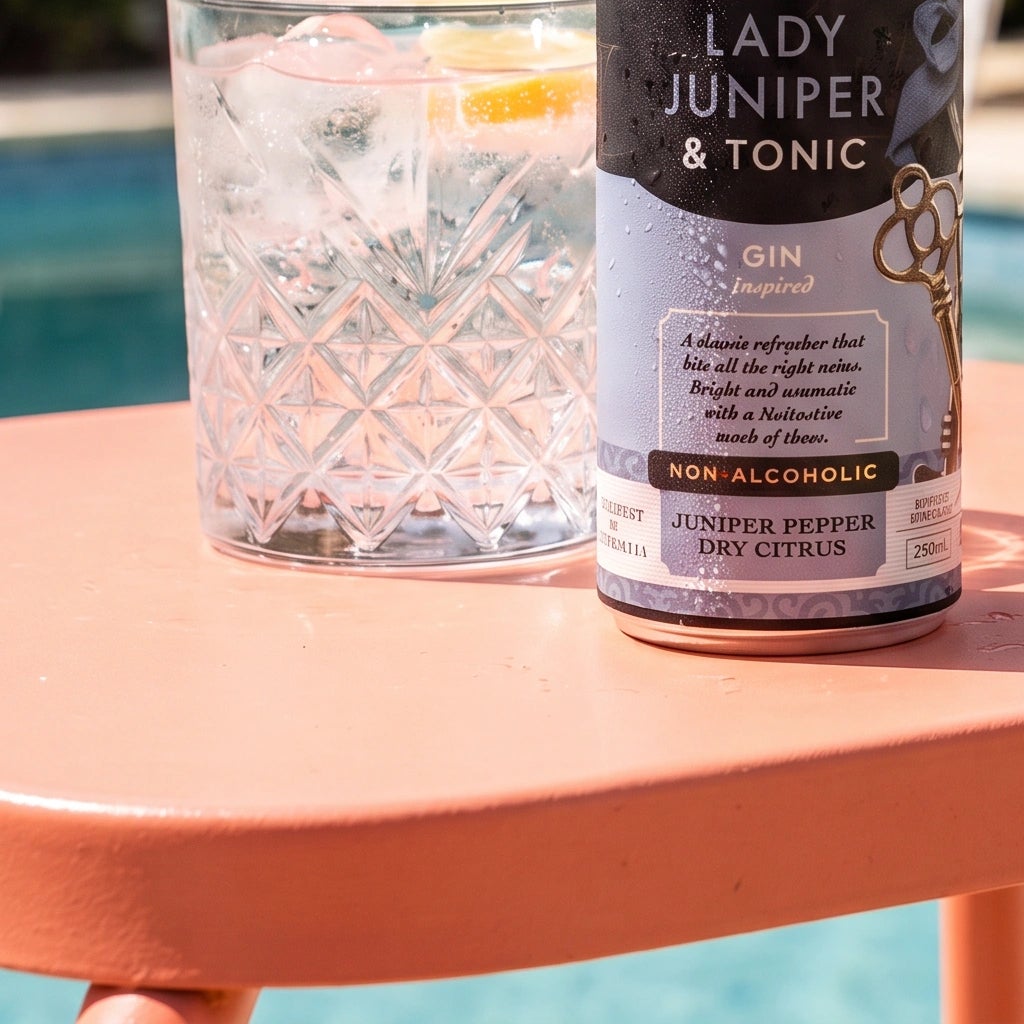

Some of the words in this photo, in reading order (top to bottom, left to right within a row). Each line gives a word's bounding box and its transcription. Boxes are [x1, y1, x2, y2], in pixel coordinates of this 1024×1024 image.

[706, 13, 846, 57] LADY
[664, 73, 885, 120] JUNIPER
[682, 136, 707, 170] &
[725, 138, 867, 171] TONIC
[743, 244, 801, 268] GIN
[680, 333, 693, 348] A
[714, 357, 737, 374] all
[689, 379, 741, 400] Bright
[744, 382, 779, 398] and
[705, 404, 738, 421] with
[742, 410, 754, 421] a
[763, 428, 782, 448] of
[672, 512, 776, 535] JUNIPER
[782, 514, 876, 535] PEPPER
[698, 538, 748, 557] DRY
[754, 539, 846, 558] CITRUS
[914, 538, 949, 559] 250mL
